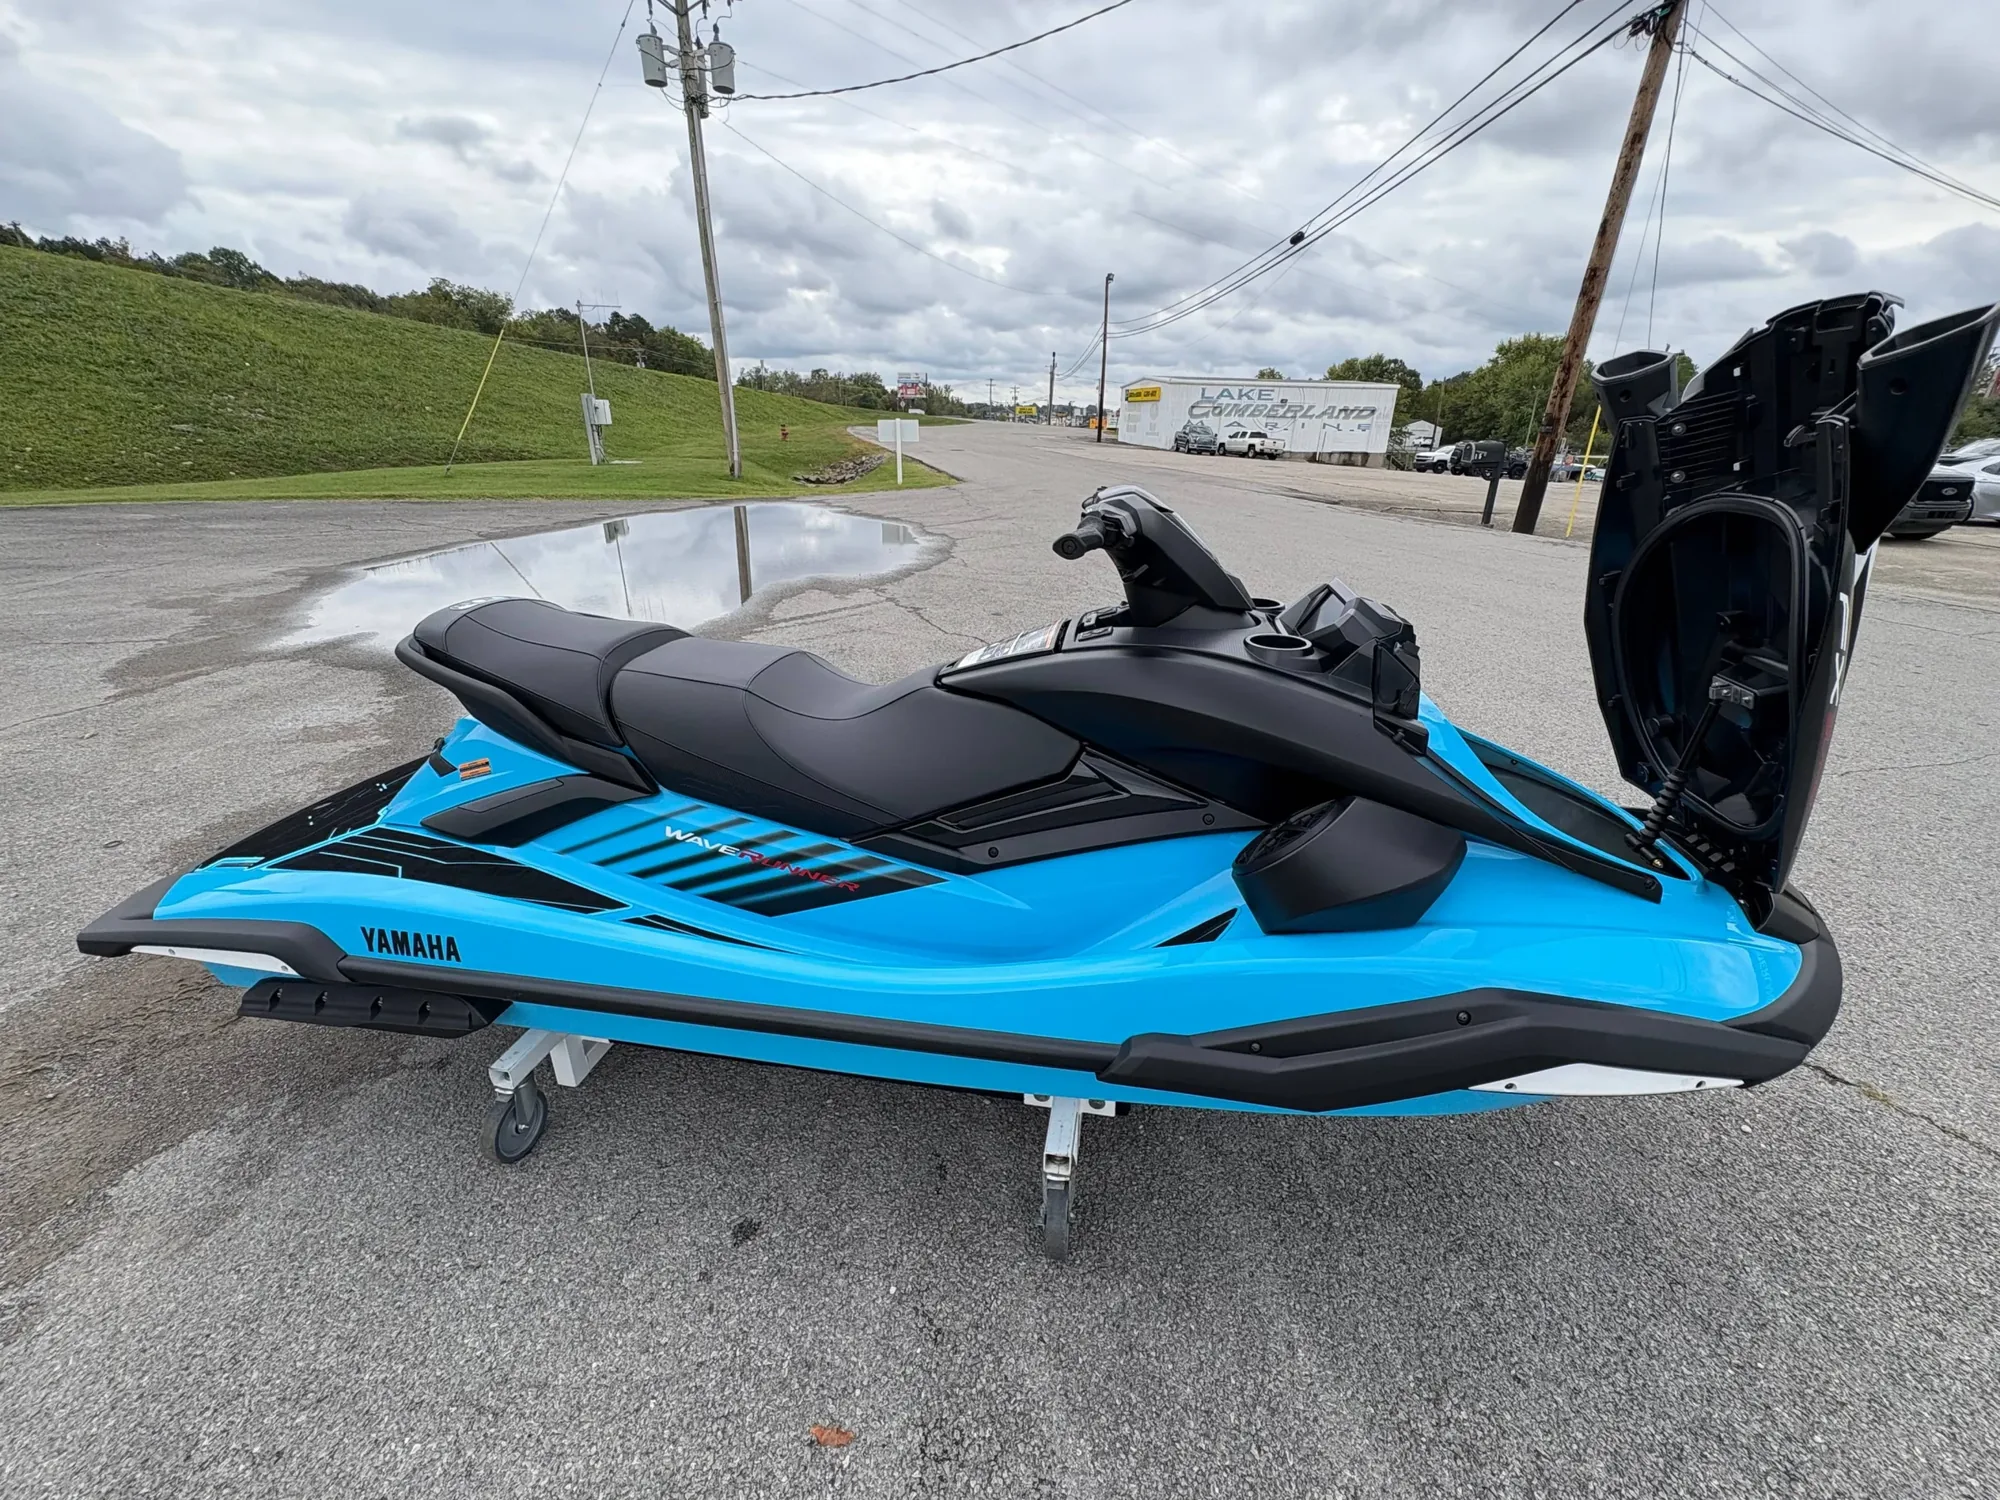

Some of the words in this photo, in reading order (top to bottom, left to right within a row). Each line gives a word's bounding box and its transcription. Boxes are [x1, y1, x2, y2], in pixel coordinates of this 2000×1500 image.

[1200, 387, 1275, 401] LAKE
[1188, 399, 1377, 420] CUMBERLAND
[665, 826, 860, 892] WAVERUNNER
[360, 926, 462, 963] YAMAHA
